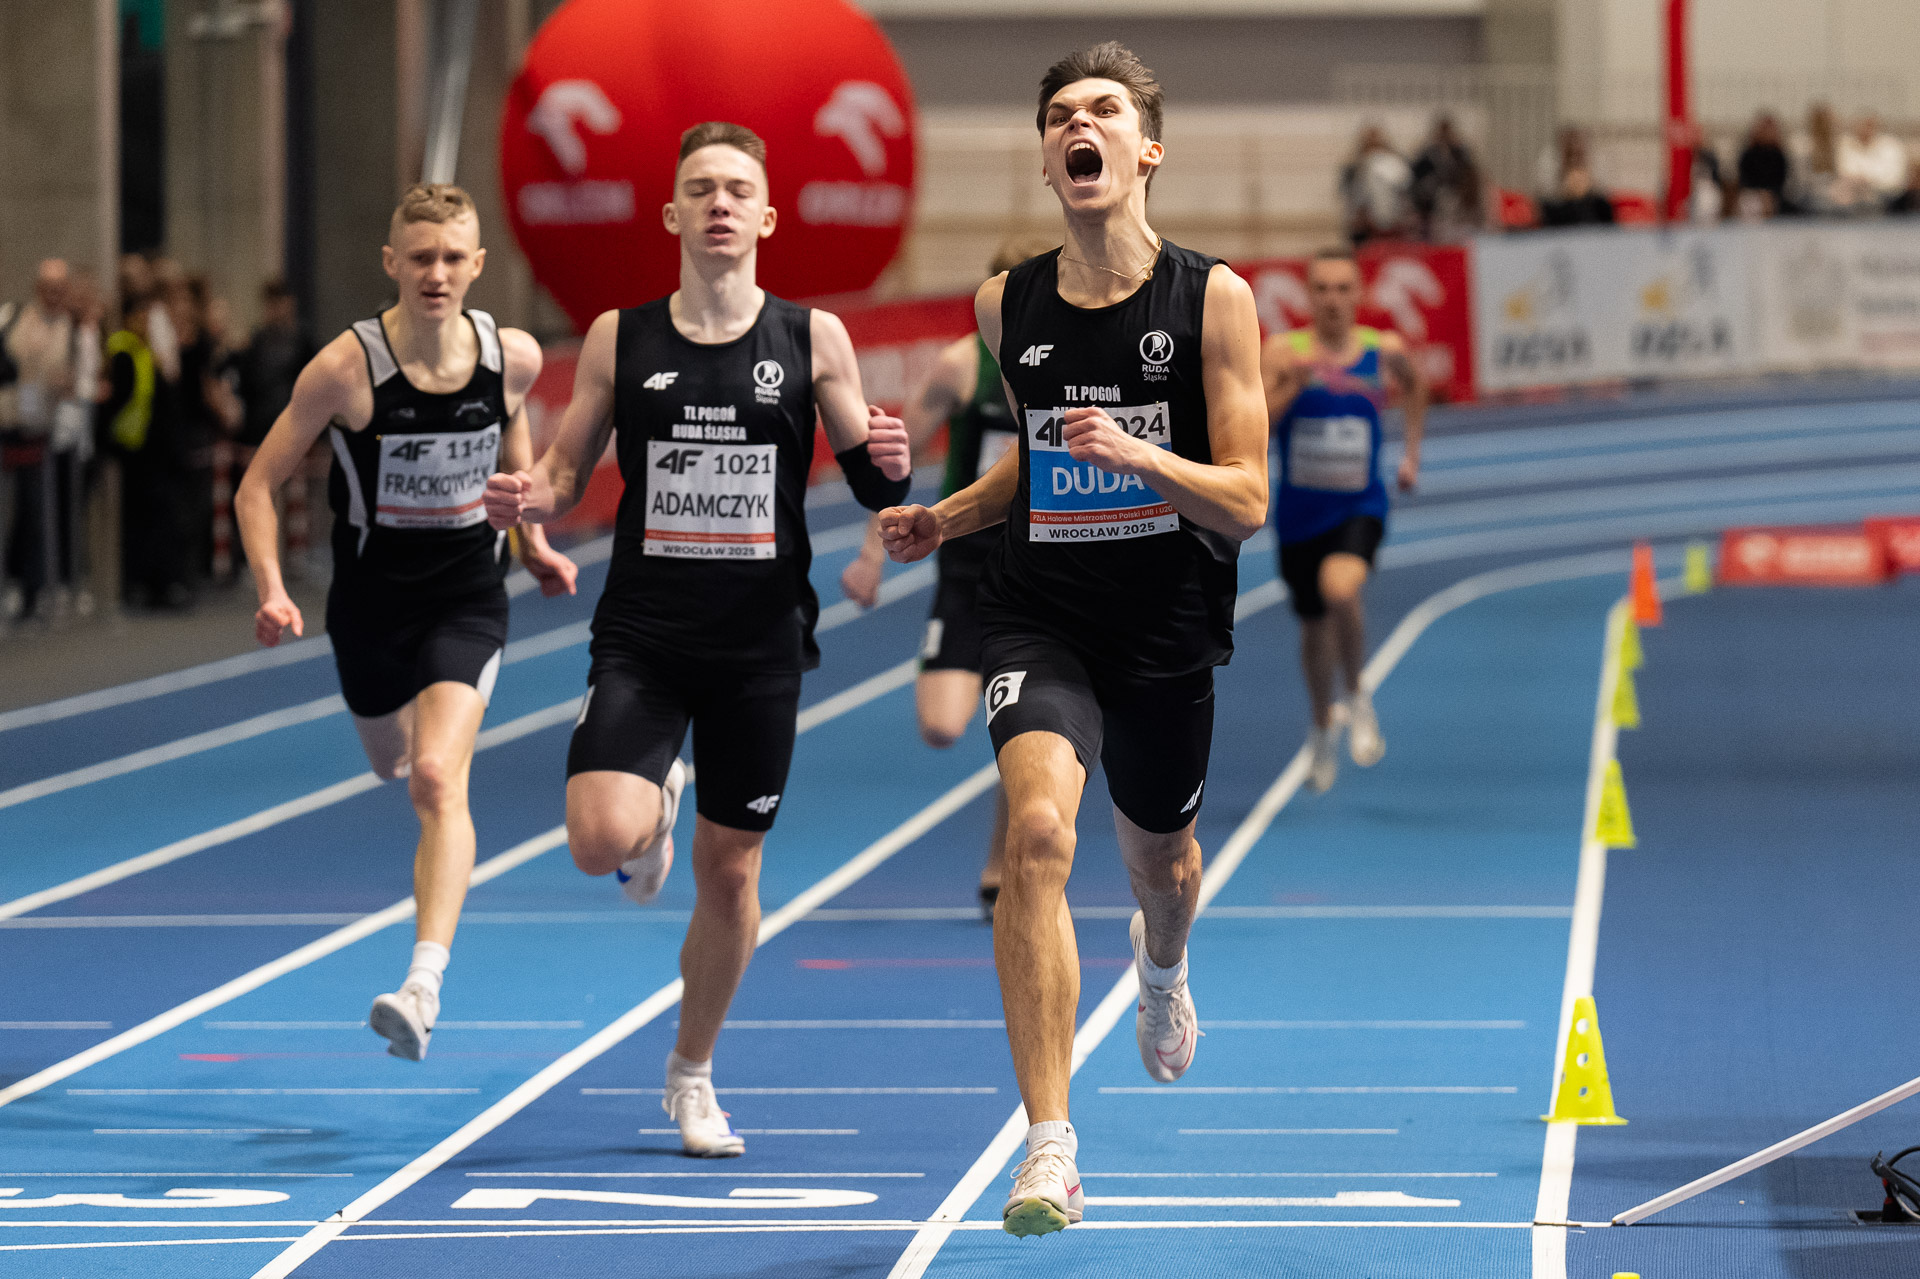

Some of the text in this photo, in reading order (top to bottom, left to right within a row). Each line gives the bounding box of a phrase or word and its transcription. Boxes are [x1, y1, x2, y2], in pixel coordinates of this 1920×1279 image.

[1019, 344, 1055, 367] 4F
[1142, 363, 1170, 374] RUDA
[1143, 373, 1168, 383] Śląska
[642, 371, 679, 391] 4F
[1064, 384, 1122, 403] TL POGOŃ
[697, 404, 737, 422] POGOŃ
[671, 423, 747, 443] RUDA ŚLĄSKA
[390, 439, 437, 461] 4F
[655, 449, 772, 475] 4F 1021
[1052, 465, 1146, 497] DUDA
[651, 490, 769, 518] ADAMCZYK
[1047, 514, 1073, 522] Halowe
[1073, 513, 1118, 522] Mistrzostwa
[1118, 511, 1141, 520] Polski
[1141, 509, 1154, 517] U18
[1159, 505, 1173, 514] U20
[1048, 521, 1156, 539] WROCŁAW 2025
[662, 543, 756, 557] WROCŁAW 2025
[989, 676, 1012, 713] 6
[746, 795, 780, 814] 4F
[450, 1188, 879, 1209] 2
